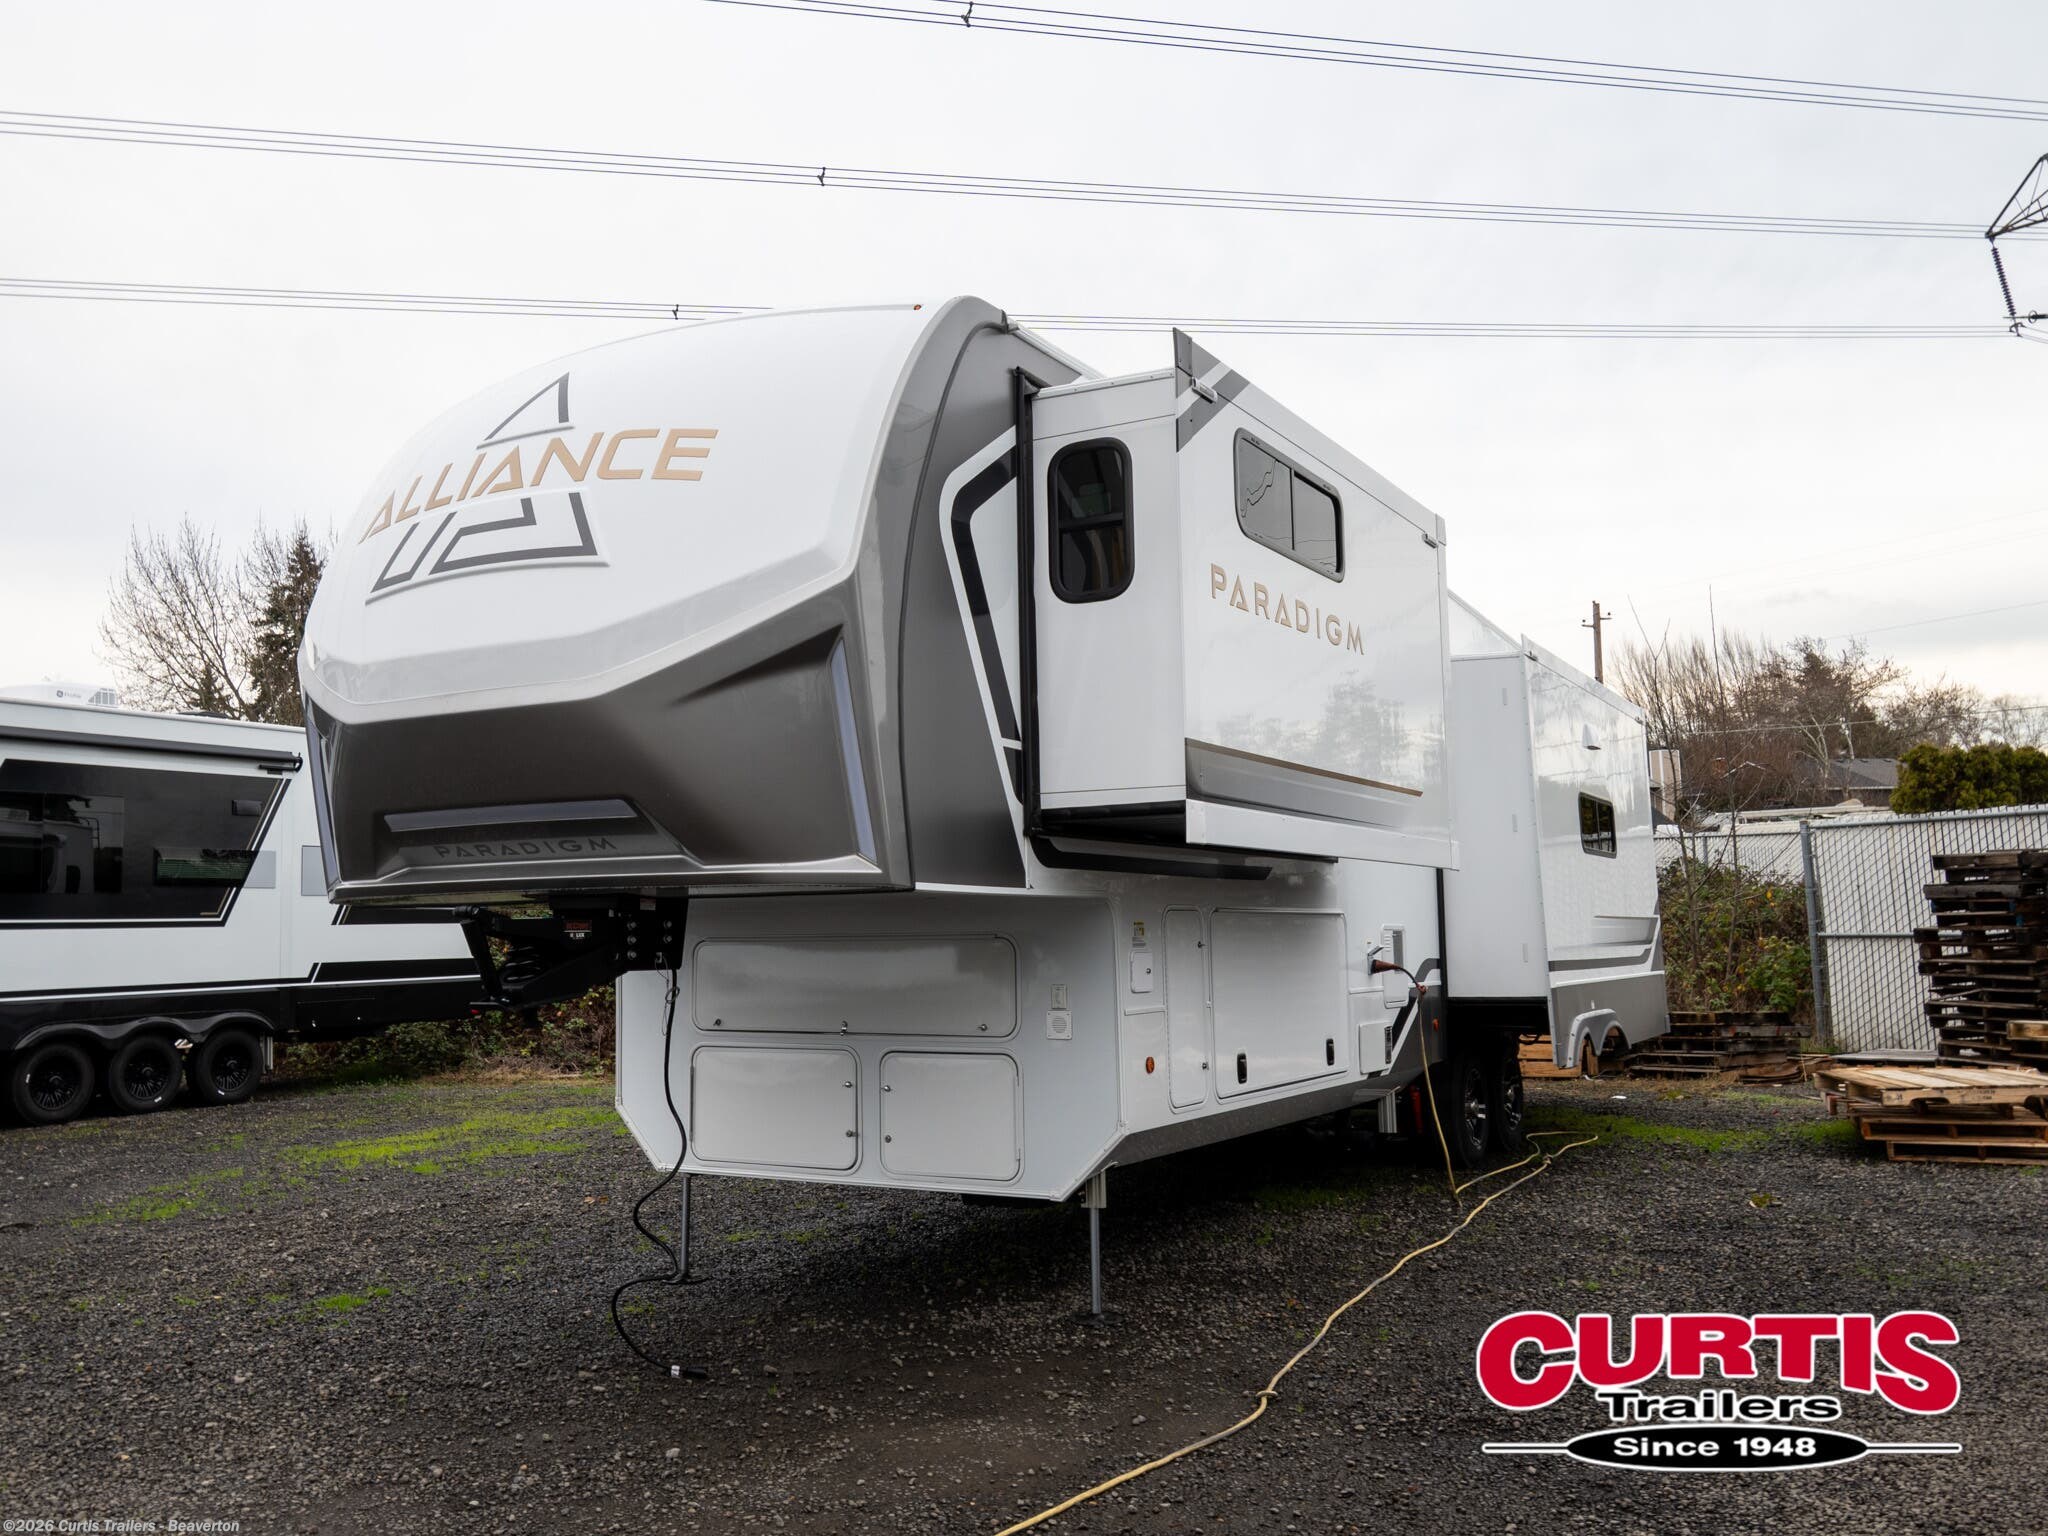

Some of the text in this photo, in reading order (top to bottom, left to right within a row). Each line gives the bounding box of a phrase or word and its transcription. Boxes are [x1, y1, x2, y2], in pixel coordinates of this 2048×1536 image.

[358, 428, 719, 545] ALLIANCE
[1210, 562, 1365, 656] PARADIGM
[433, 838, 617, 859] PARADIGM
